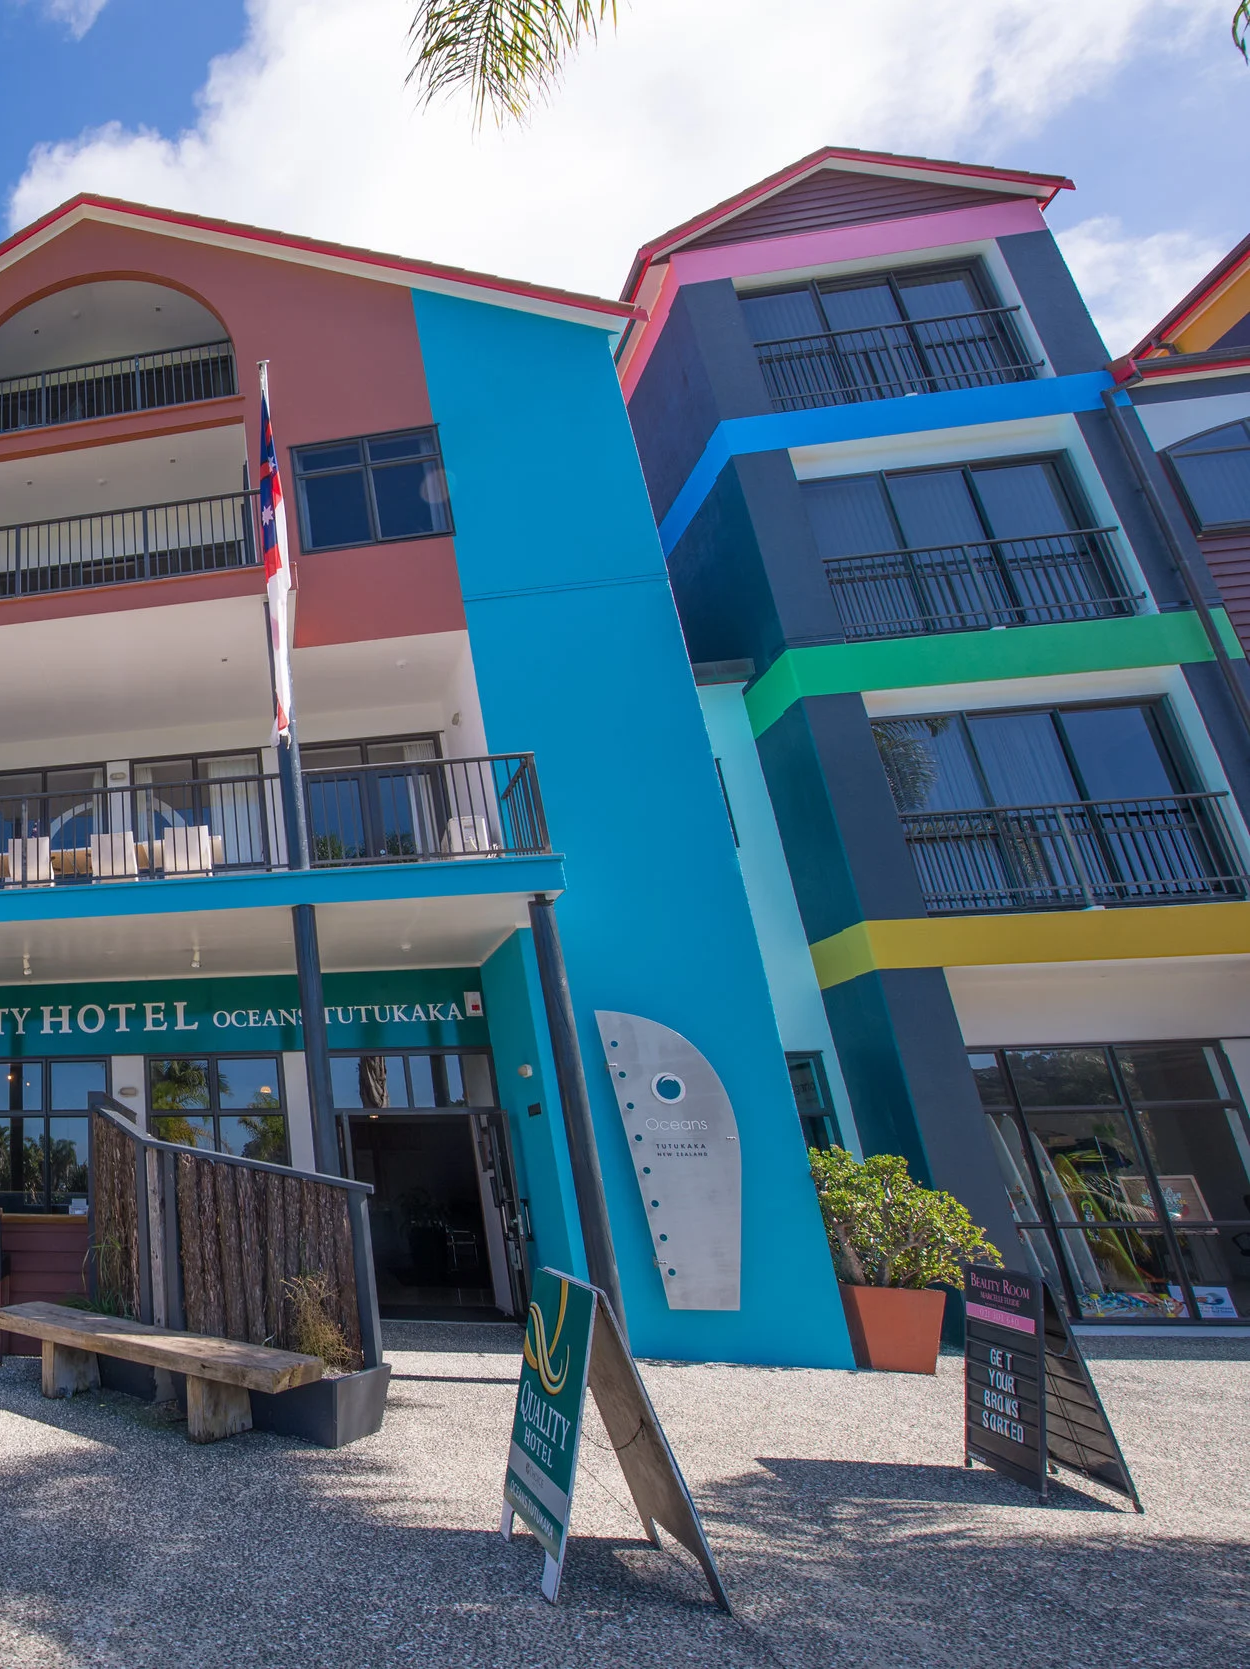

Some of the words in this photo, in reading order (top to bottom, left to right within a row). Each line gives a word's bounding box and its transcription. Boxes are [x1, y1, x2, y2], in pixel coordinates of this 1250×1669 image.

[40, 1001, 199, 1034] HOTEL
[324, 1003, 464, 1024] TUTUKAKA
[645, 1118, 708, 1130] Oceans
[970, 1272, 1000, 1293] BEAUTY
[1003, 1279, 1030, 1300] ROOM
[989, 1348, 1013, 1371] GET
[988, 1368, 1016, 1395] YOUR
[519, 1380, 571, 1451] QUALITY
[983, 1389, 1019, 1419] BROWS
[982, 1410, 1024, 1444] SORTED
[524, 1426, 553, 1469] HOTEL
